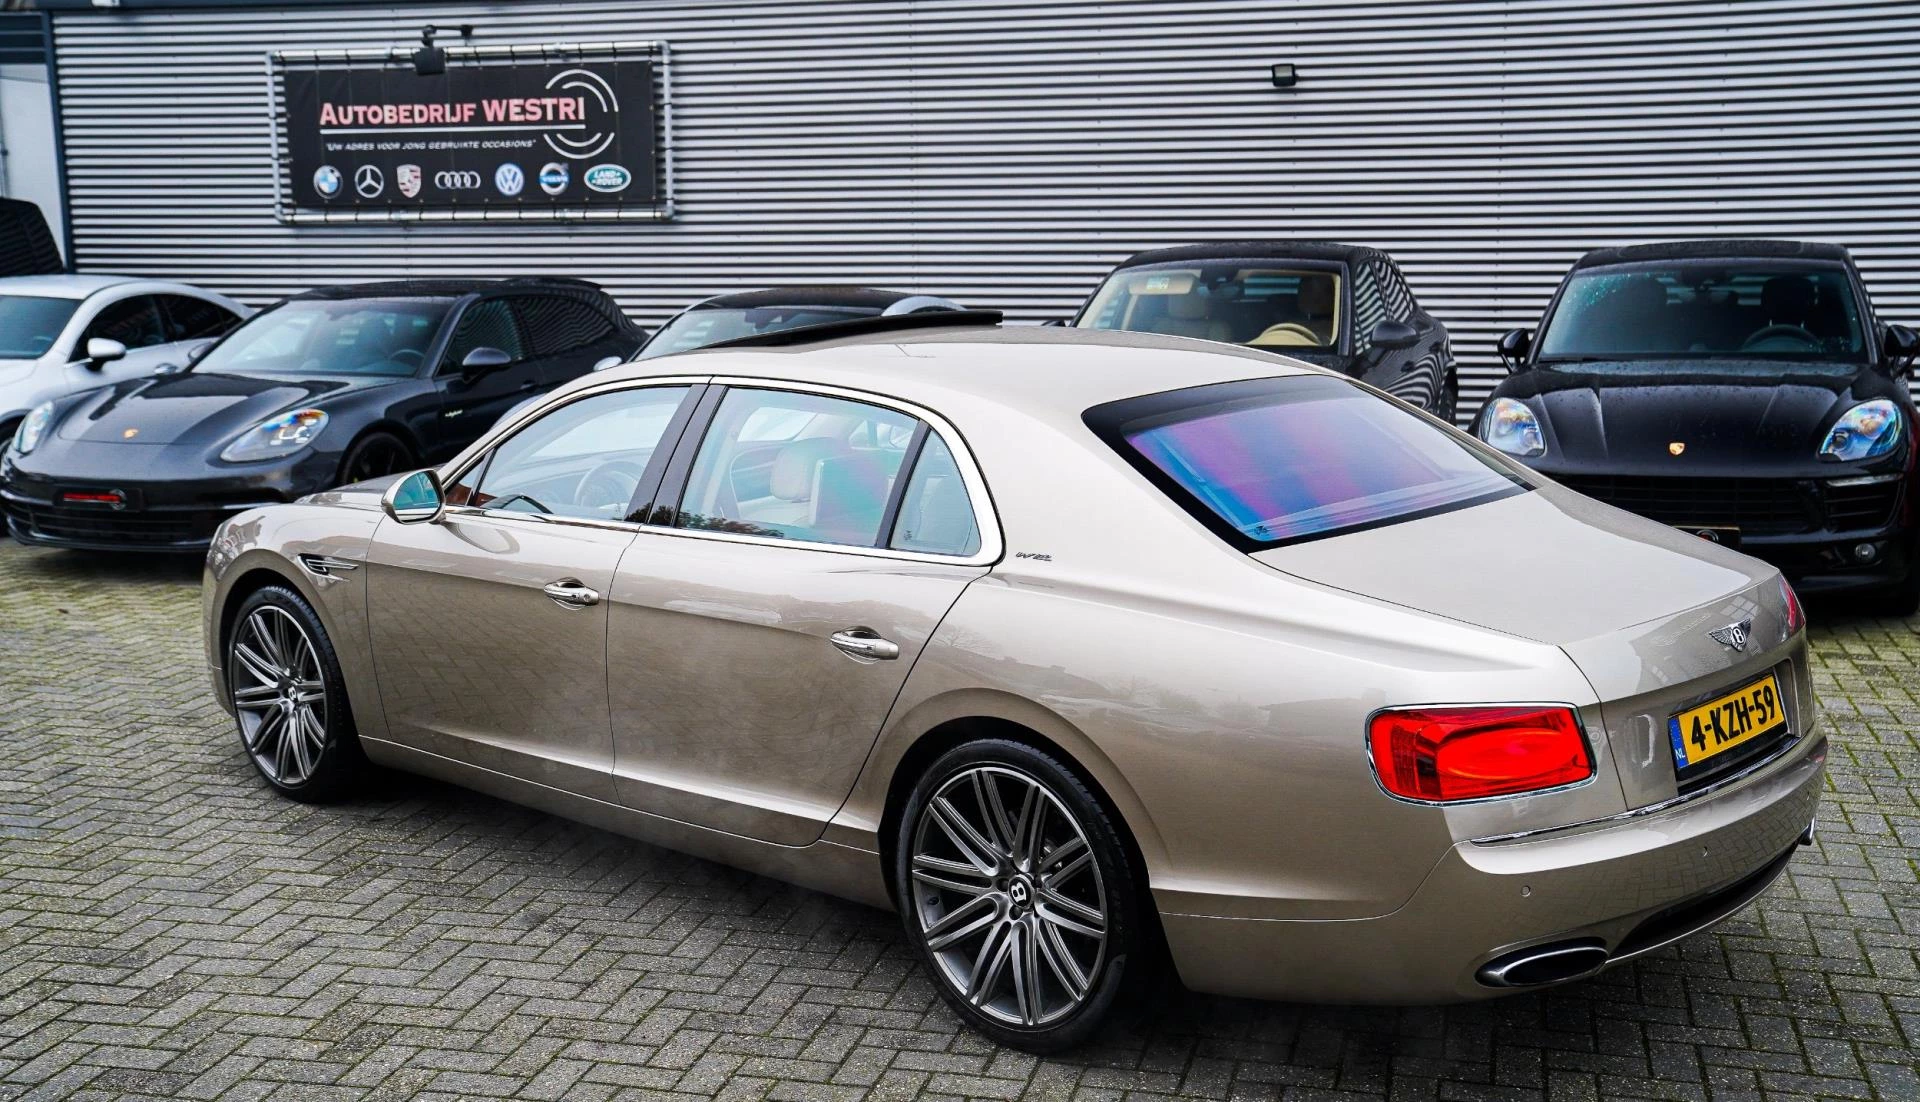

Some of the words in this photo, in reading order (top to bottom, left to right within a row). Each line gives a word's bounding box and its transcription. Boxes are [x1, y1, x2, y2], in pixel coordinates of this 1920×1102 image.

[320, 102, 476, 126] AUTOBEDRIJF
[481, 96, 585, 122] WESTRI
[377, 141, 400, 150] VOOR
[401, 141, 426, 150] JONG
[428, 141, 480, 150] GEBRUIKTE
[1691, 685, 1775, 752] 4-KZH-59
[1674, 747, 1686, 760] NL
